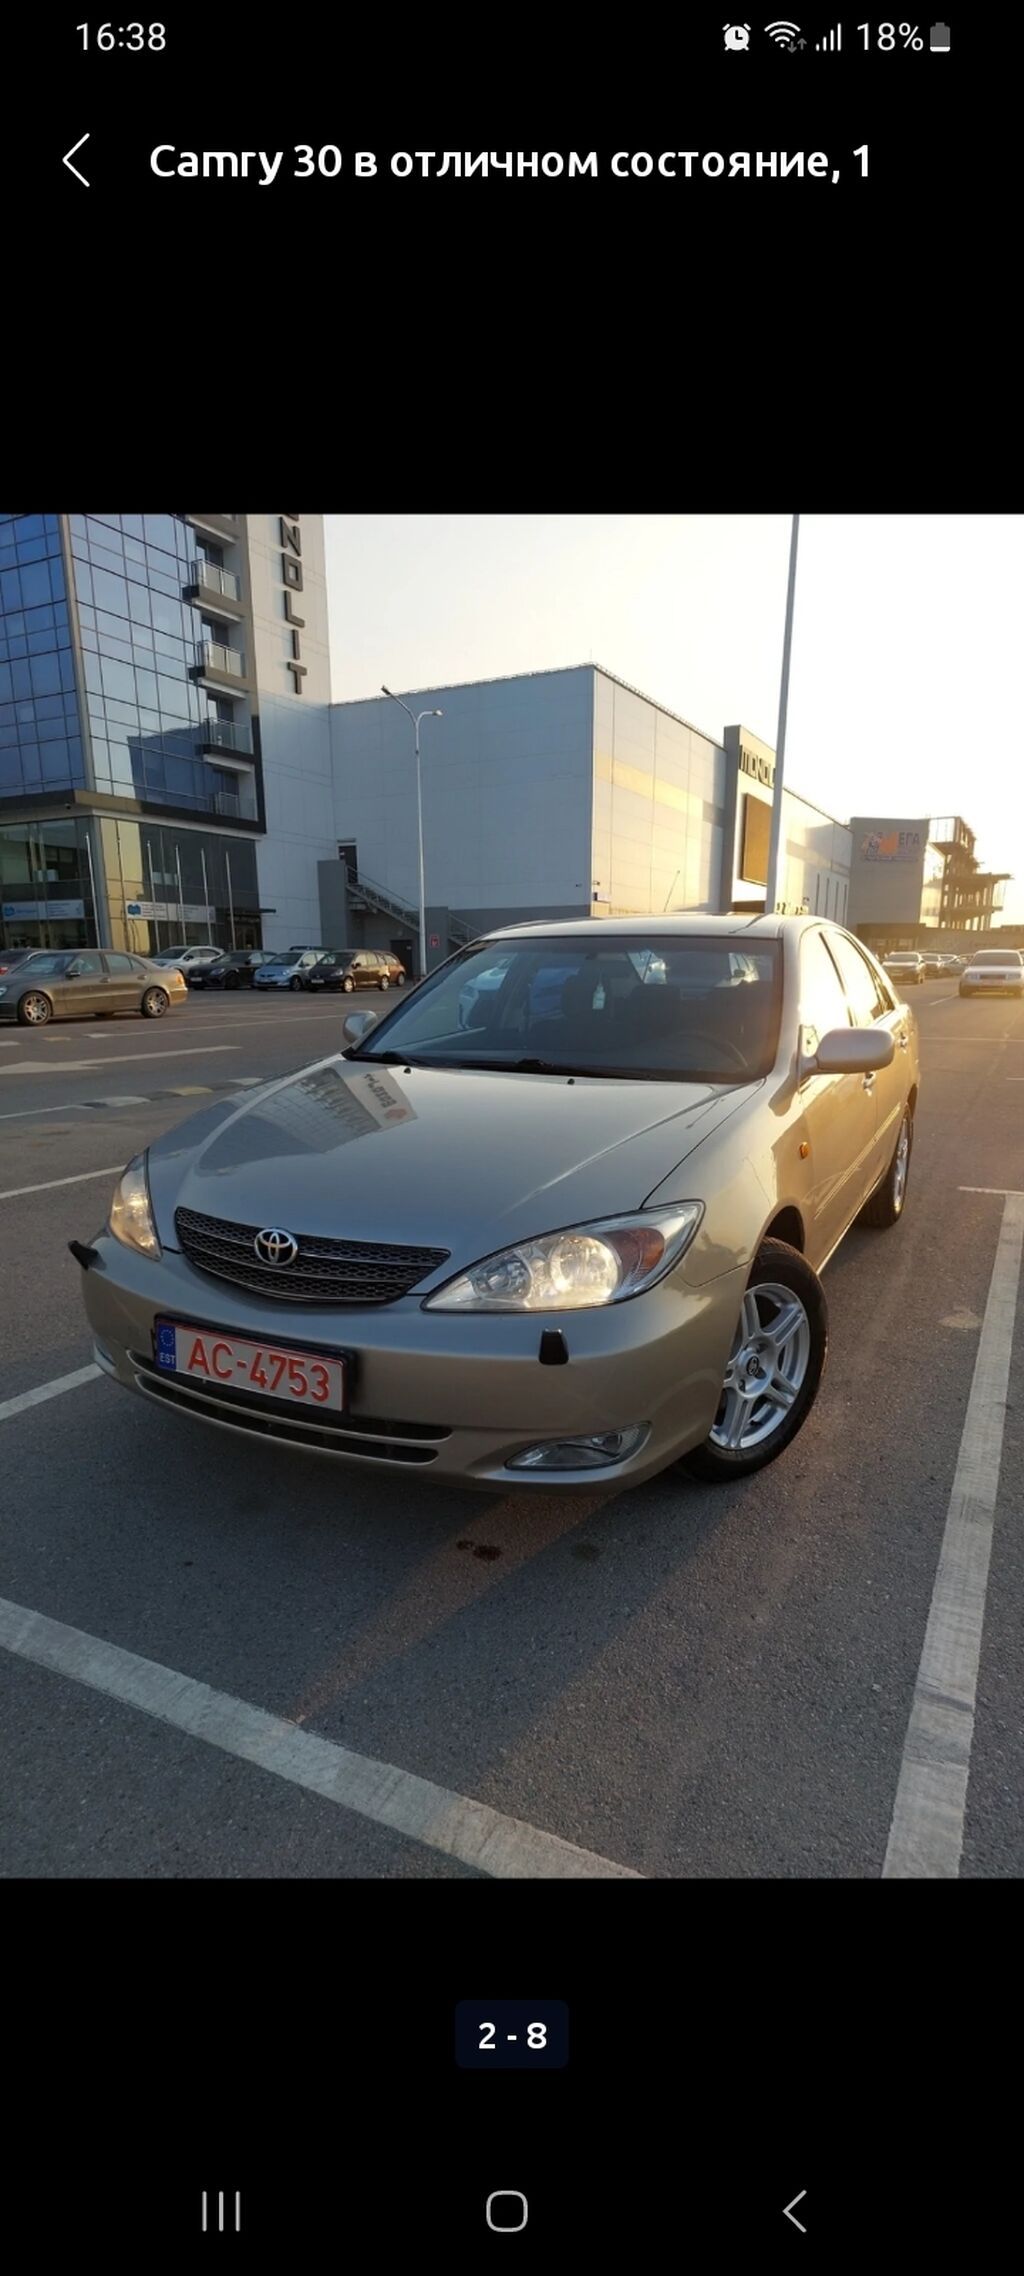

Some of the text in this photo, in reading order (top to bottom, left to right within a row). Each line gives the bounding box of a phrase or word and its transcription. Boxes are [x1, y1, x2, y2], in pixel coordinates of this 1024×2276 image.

[280, 514, 307, 695] NOLIT
[159, 1351, 176, 1365] EST
[187, 1337, 330, 1402] AC-4753
